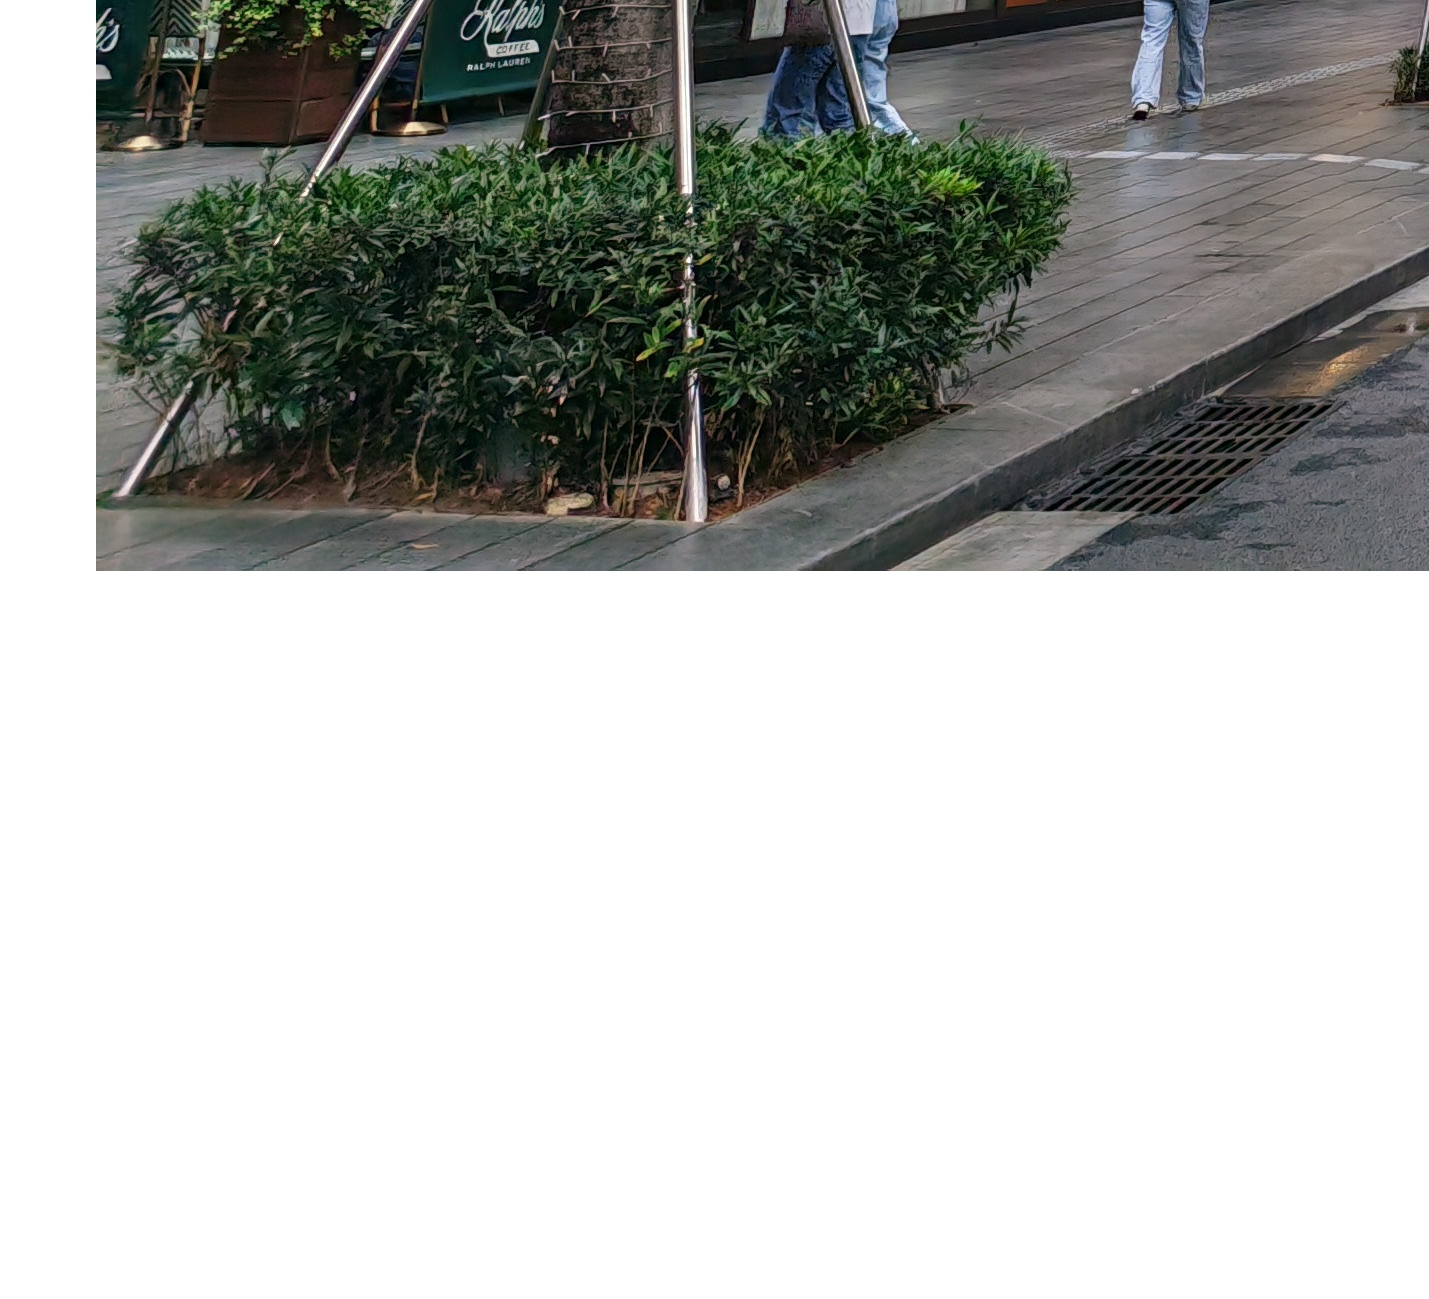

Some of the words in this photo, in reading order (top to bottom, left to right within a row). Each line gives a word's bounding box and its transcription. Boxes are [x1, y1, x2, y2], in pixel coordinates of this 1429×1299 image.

[496, 42, 531, 55] COFFEE
[467, 62, 496, 72] RALPH
[498, 57, 531, 69] LAUREN
